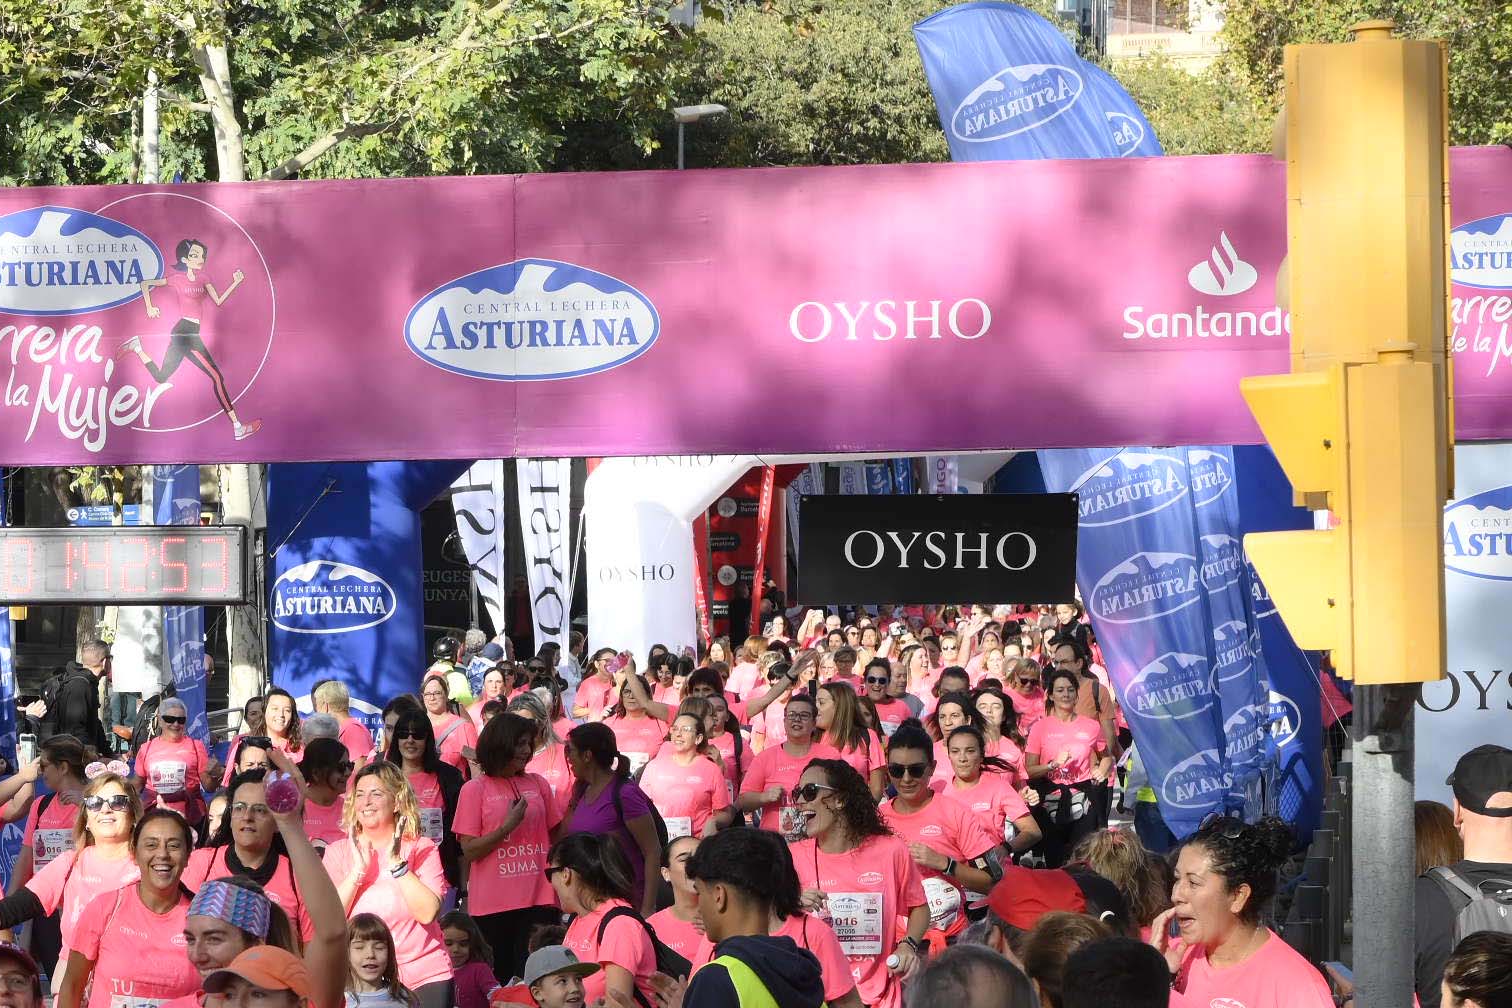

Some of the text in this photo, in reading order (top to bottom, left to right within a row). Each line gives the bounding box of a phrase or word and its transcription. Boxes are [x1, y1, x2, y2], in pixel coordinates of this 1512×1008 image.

[67, 243, 139, 255] LECHERA
[463, 299, 632, 314] CENTRAL LECHERA
[424, 306, 640, 352] ASTURIANA
[789, 297, 992, 343] OYSHO
[5, 367, 30, 408] la
[24, 358, 174, 453] Mujer
[844, 530, 1037, 571] OYSHO
[3, 537, 228, 593] 01:42:53
[600, 563, 675, 584] OYSHO
[286, 585, 383, 595] CENTRAL LECHERA
[274, 590, 387, 619] ASTURIANA
[1415, 670, 1512, 713] OY
[497, 842, 547, 859] DORSAL
[499, 859, 538, 875] SUMA
[834, 917, 858, 926] 016
[110, 978, 134, 995] TU
